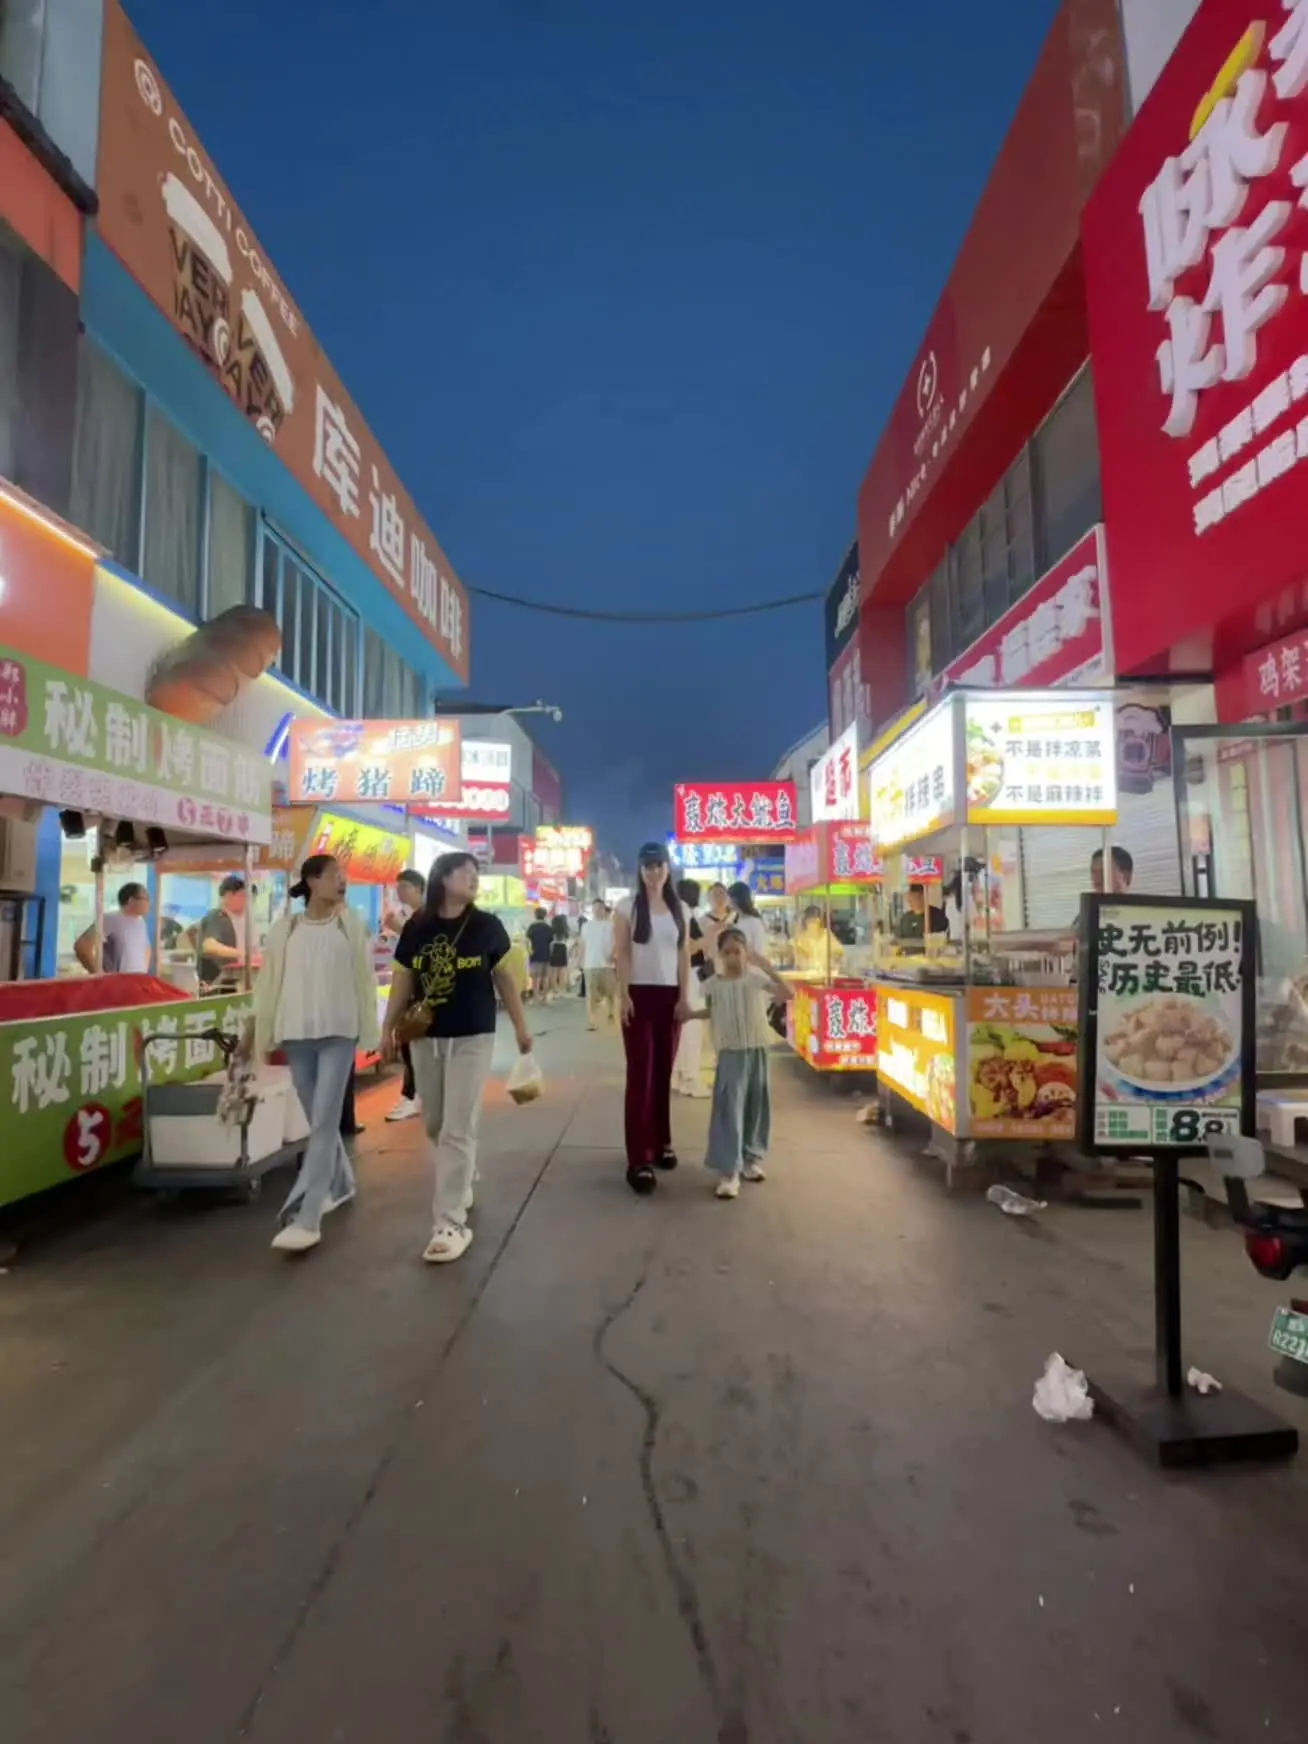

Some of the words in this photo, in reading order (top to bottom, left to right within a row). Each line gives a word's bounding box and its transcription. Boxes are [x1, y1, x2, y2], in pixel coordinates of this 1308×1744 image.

[168, 117, 232, 231] COTTI
[235, 228, 297, 337] COFFEE
[312, 383, 463, 660] 库迪咖啡
[1258, 639, 1308, 698] 鸡架
[301, 765, 447, 799] 烤猪蹄
[1099, 920, 1242, 957] 史无前例!
[983, 992, 1039, 1020] 大头
